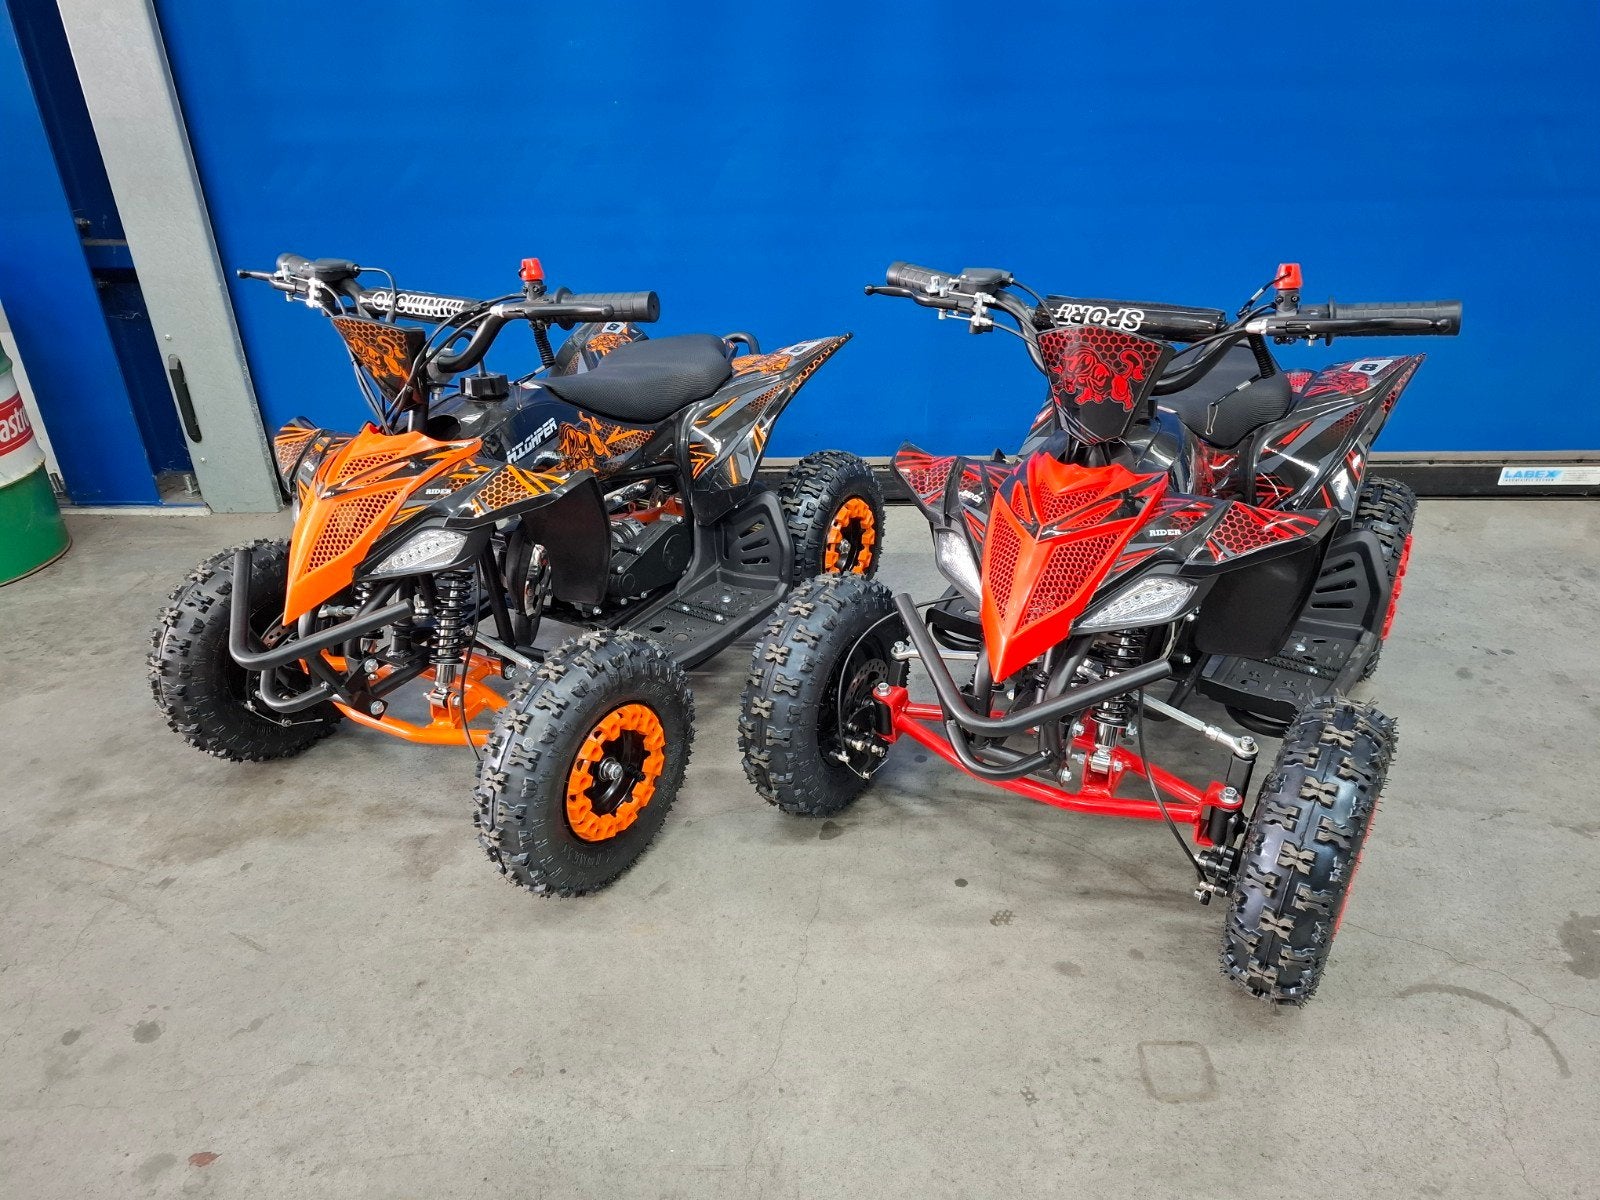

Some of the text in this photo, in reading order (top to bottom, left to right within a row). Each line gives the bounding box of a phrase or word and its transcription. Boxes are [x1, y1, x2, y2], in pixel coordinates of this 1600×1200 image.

[1053, 304, 1145, 331] SPORT
[1358, 363, 1379, 372] 8
[1503, 470, 1561, 479] LABEX
[1149, 529, 1182, 537] RIDER
